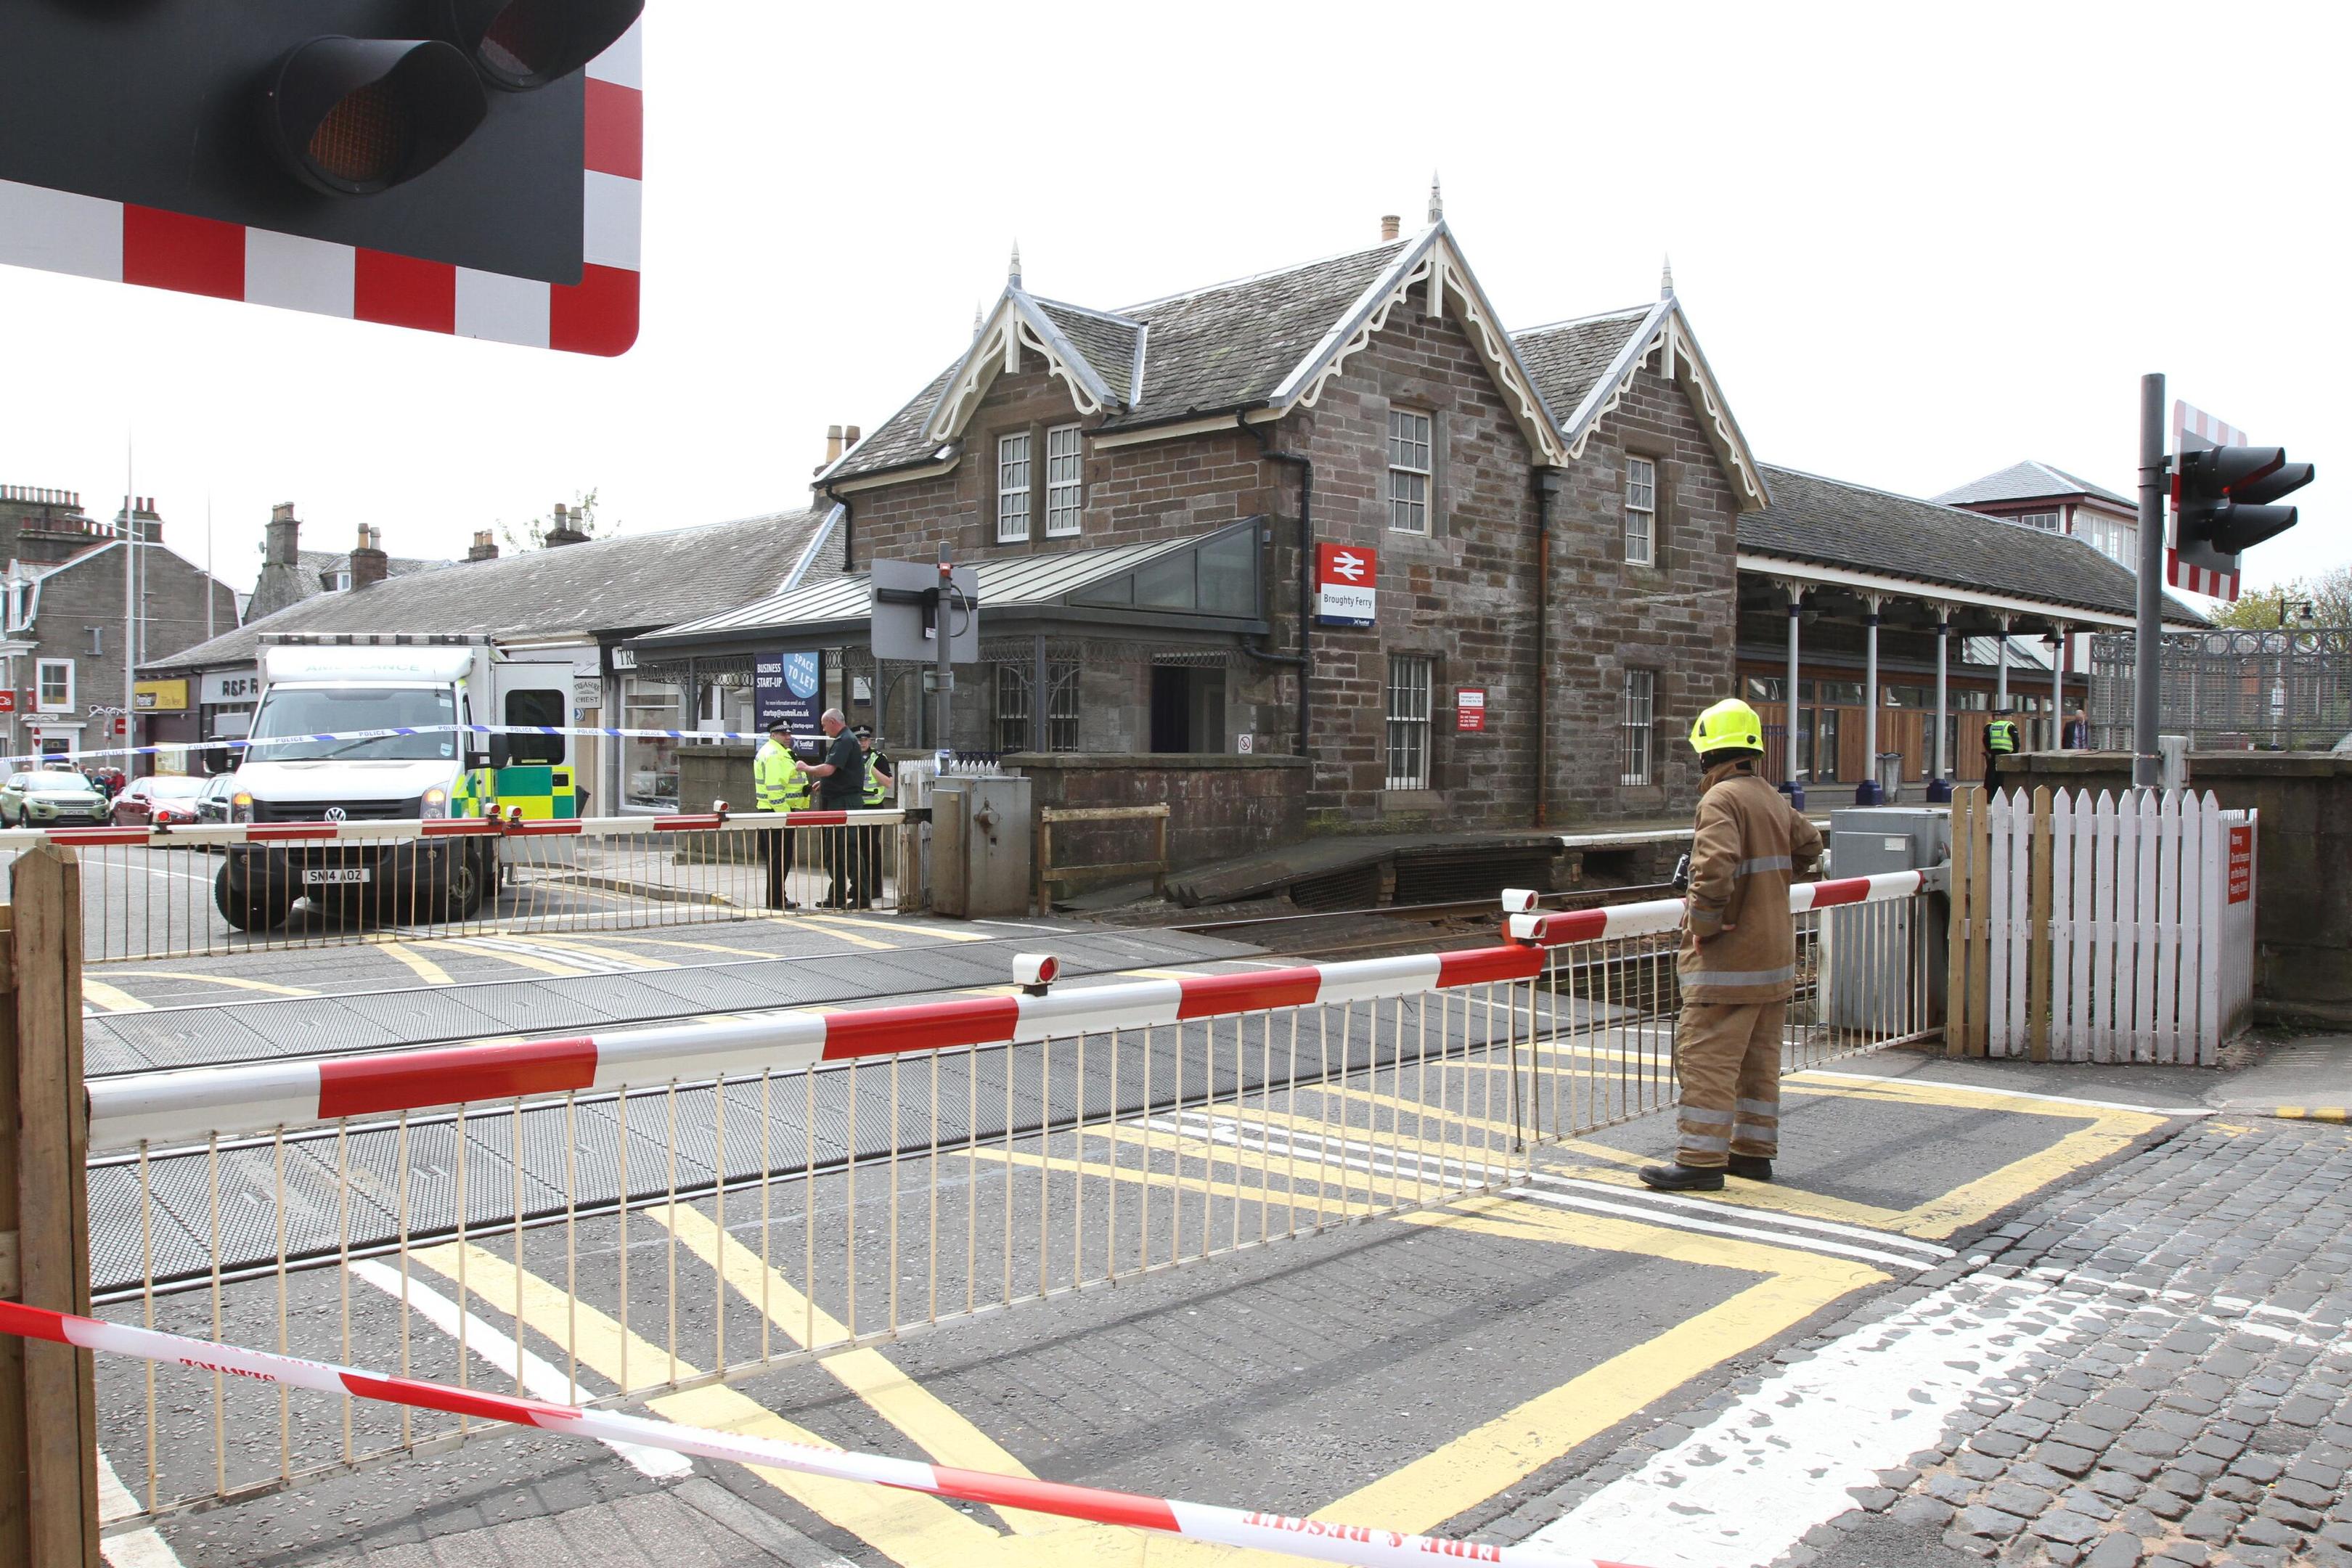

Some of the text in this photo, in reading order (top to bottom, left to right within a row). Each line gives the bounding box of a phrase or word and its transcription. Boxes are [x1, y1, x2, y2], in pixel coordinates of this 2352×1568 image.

[1324, 594, 1372, 608] Broughty Ferry
[757, 663, 781, 673] BUSINESS
[794, 653, 814, 672] SPACE
[757, 677, 783, 688] START-UP
[788, 665, 798, 679] TO
[800, 672, 814, 690] LET
[574, 681, 601, 691] TREASURE
[763, 709, 809, 718] startup@scotrail.co.uk
[311, 870, 335, 881] SN14
[1421, 1536, 1501, 1563] FIRE
